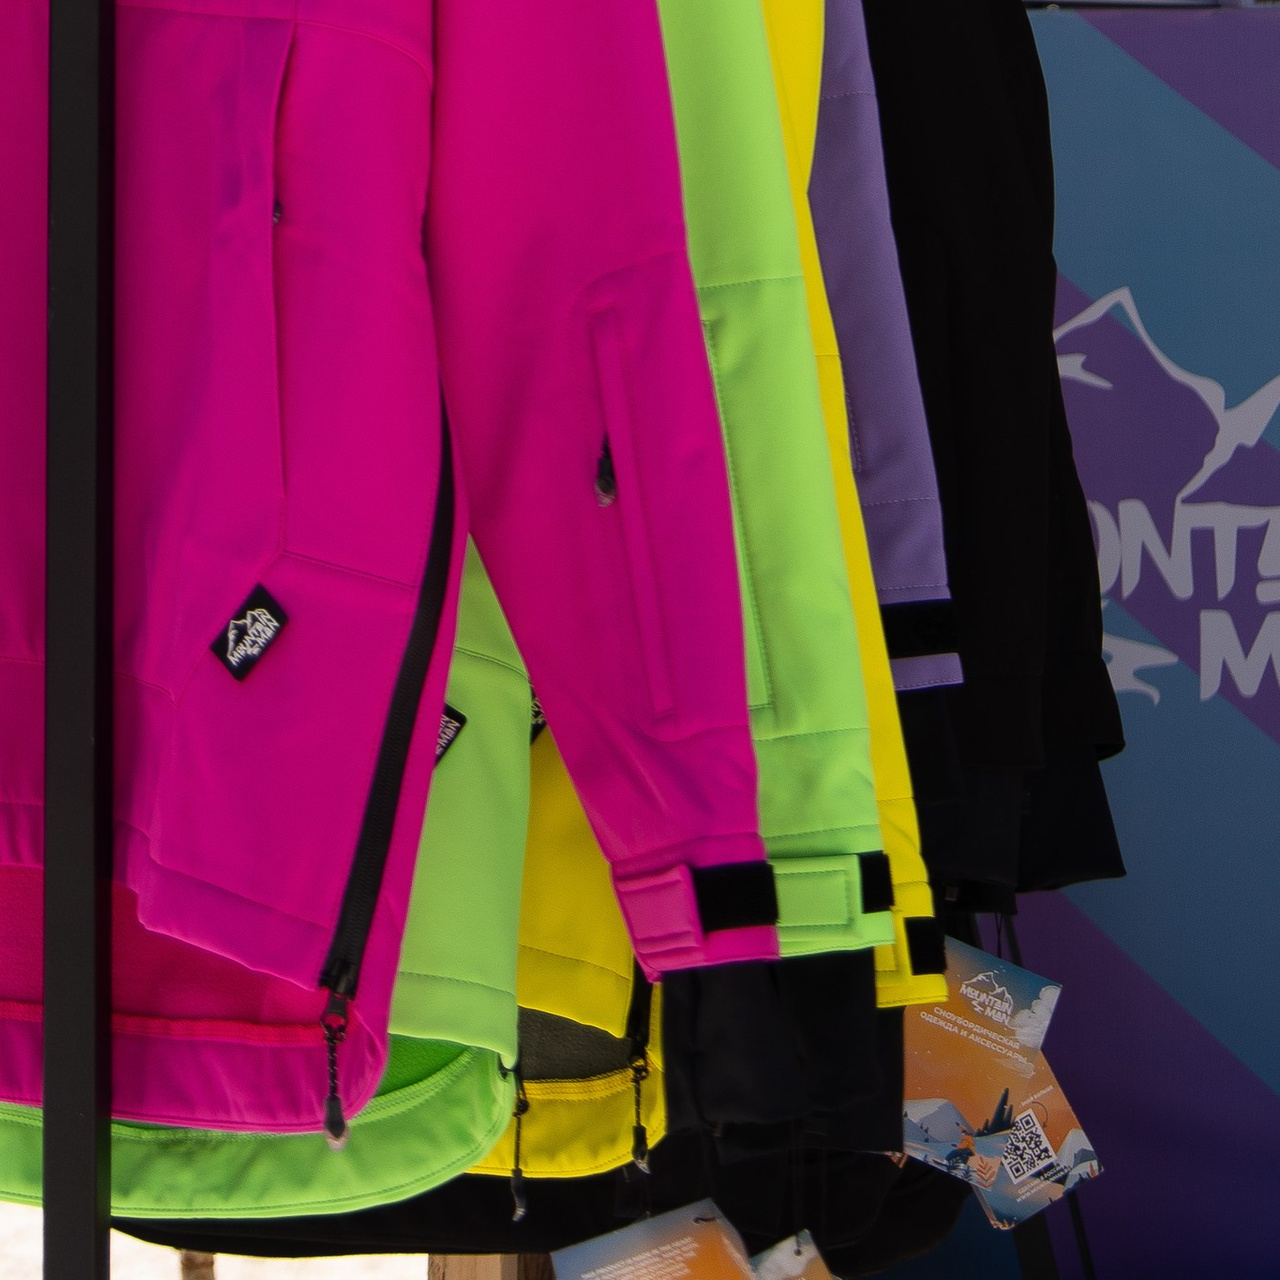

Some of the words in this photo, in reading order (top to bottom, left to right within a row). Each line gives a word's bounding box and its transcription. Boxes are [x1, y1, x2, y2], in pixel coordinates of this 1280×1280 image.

[227, 609, 273, 666] MOUNTAIN
[255, 616, 281, 649] MAN
[959, 983, 1015, 1015] MOUNTAIN
[985, 1008, 1011, 1026] MAN
[919, 1010, 960, 1035] ОДЕЖДА
[960, 1027, 968, 1038] И
[968, 1032, 1029, 1064] АКСЕССУАРЫ
[933, 1006, 1021, 1050] СНОУБОРДИЧЕСКАЯ
